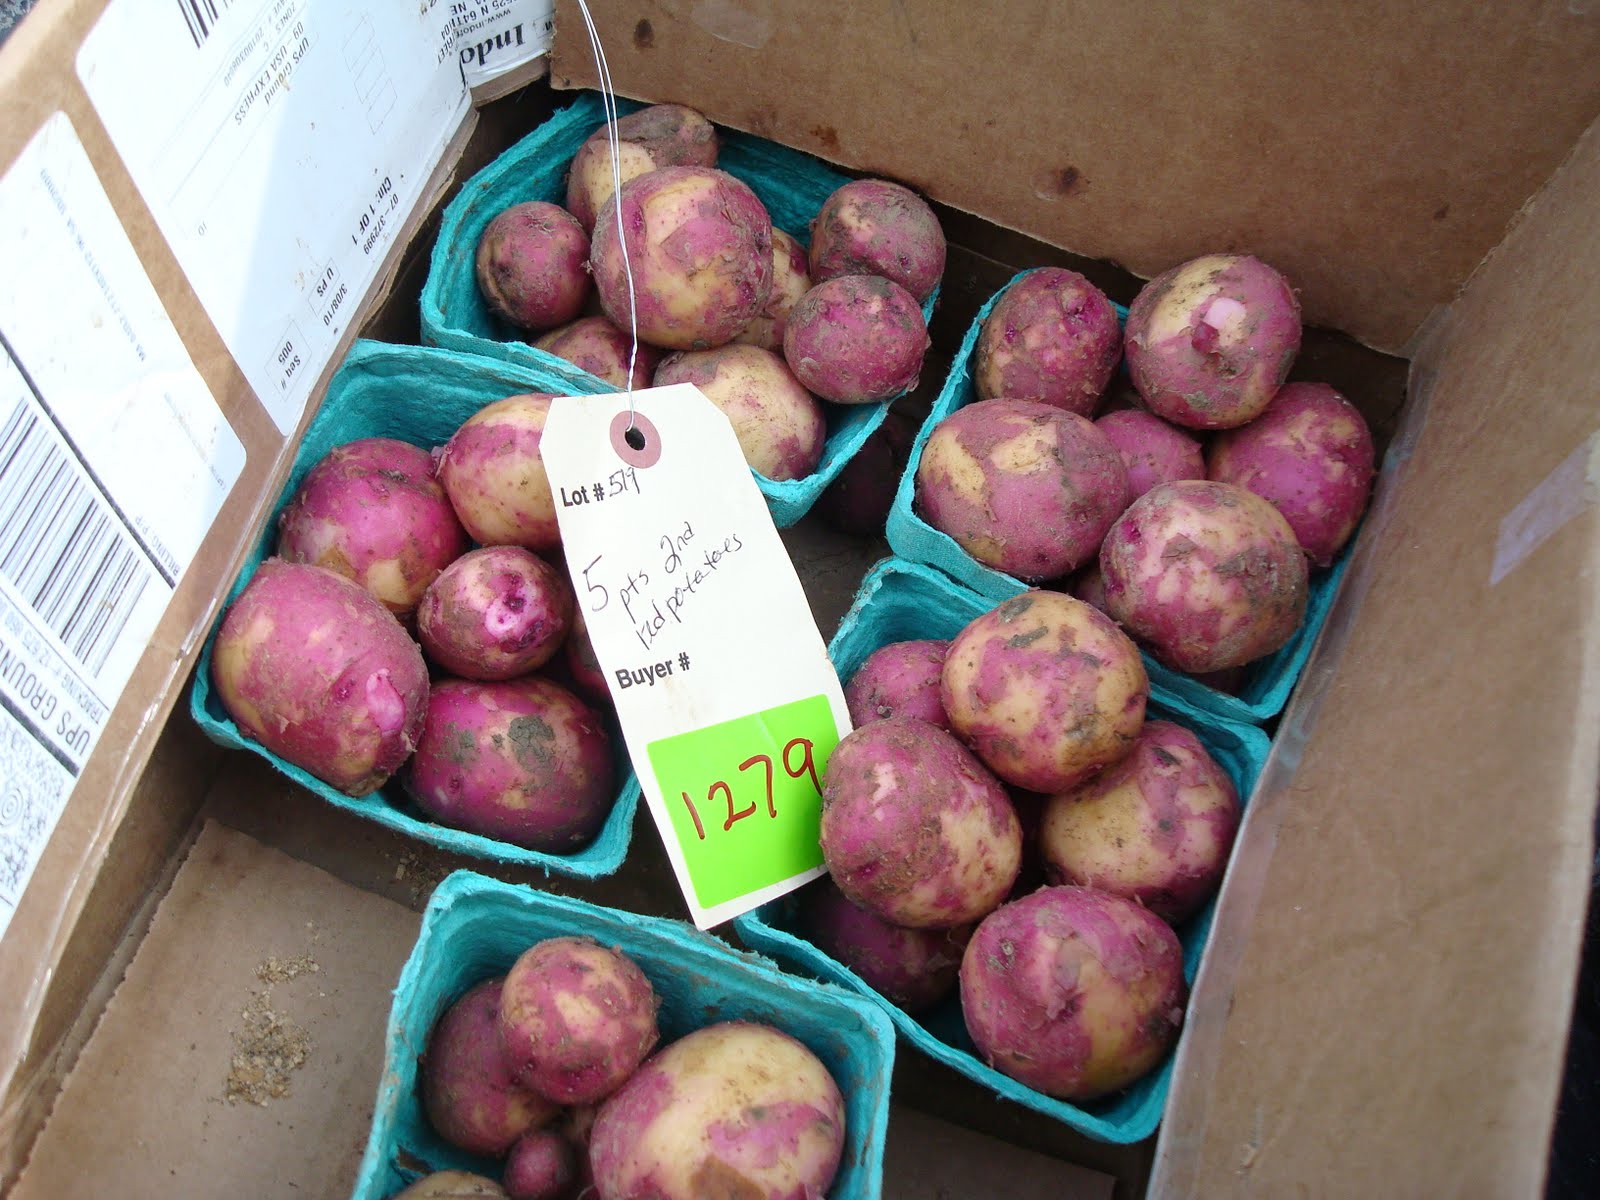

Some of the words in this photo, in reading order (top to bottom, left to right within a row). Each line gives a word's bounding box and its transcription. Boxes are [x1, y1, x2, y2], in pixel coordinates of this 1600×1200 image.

[270, 45, 288, 72] USA
[291, 37, 309, 64] UPS
[234, 70, 271, 125] EXPRESS
[264, 62, 292, 105] Ground
[359, 216, 370, 235] OF
[278, 340, 293, 366] 005
[285, 355, 301, 378] Seq
[561, 486, 590, 507] Lot
[593, 483, 604, 501] #
[582, 555, 608, 612] 5
[619, 569, 649, 624] pts
[615, 659, 673, 689] Buyer
[679, 652, 691, 671] #
[56, 710, 90, 756] UPS
[682, 738, 822, 840] 1279
